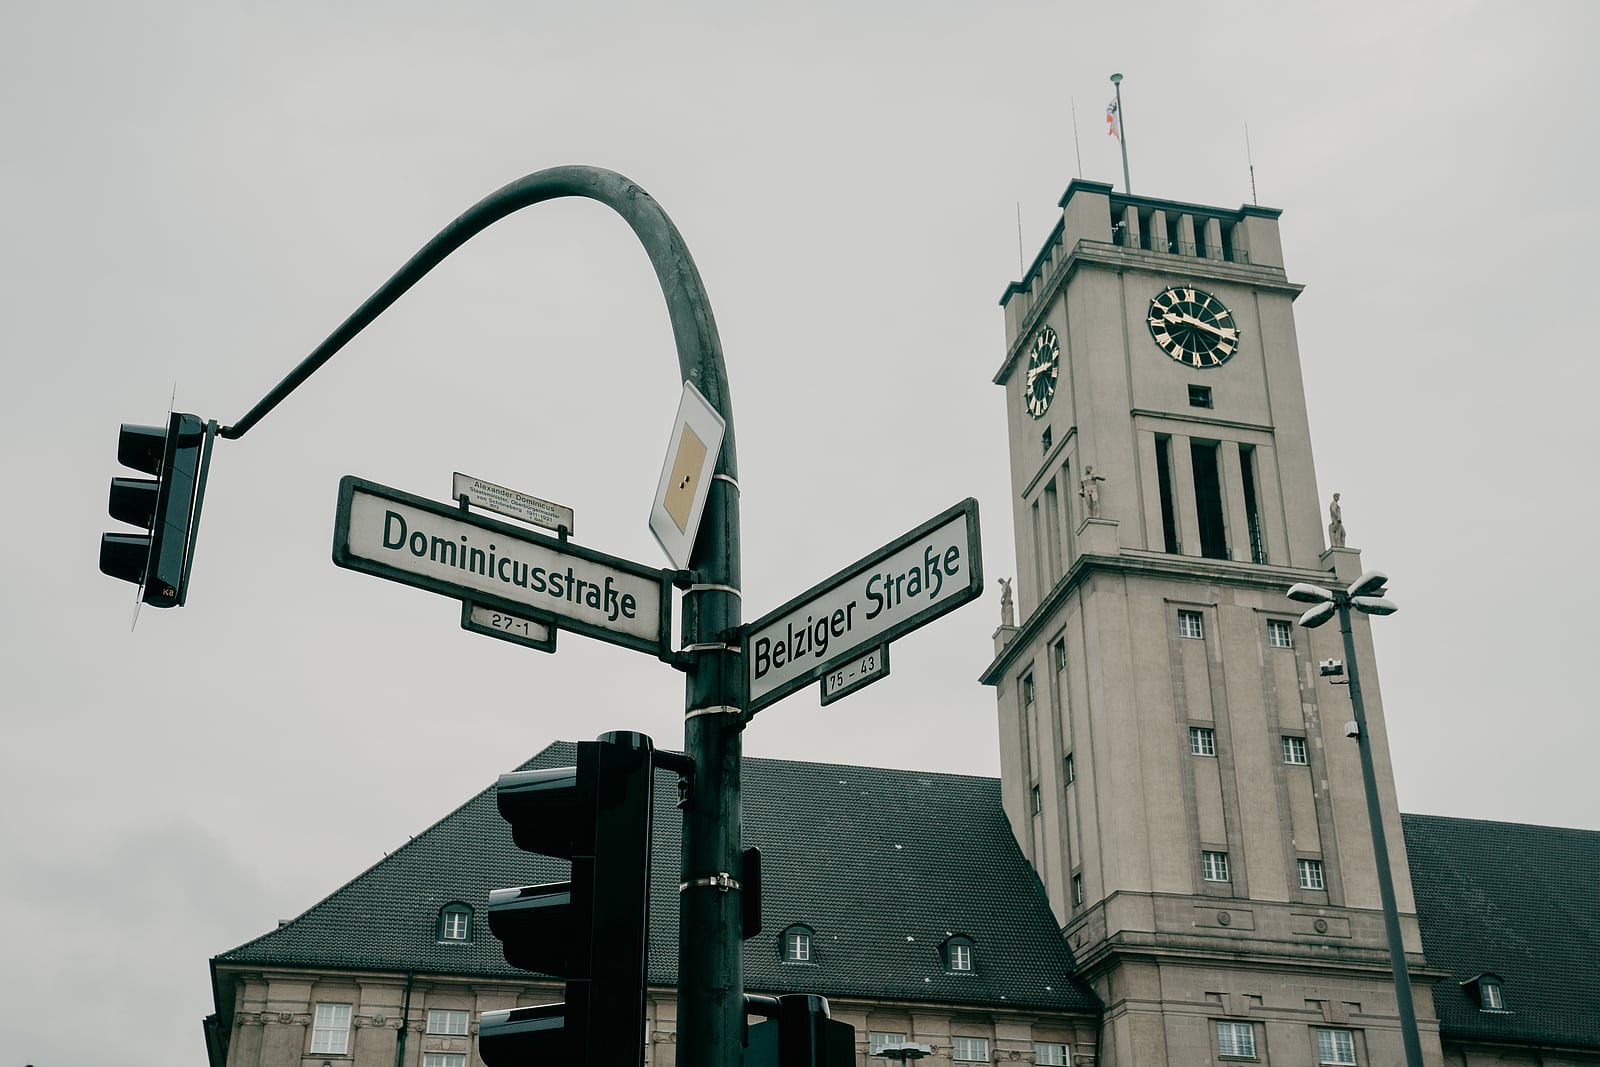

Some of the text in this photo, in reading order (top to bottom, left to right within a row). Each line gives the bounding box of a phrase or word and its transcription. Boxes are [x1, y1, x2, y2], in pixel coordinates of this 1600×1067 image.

[474, 481, 555, 512] Alexander Dominicus
[383, 509, 637, 622] Dominicusstraße
[492, 614, 529, 636] 27-1
[754, 544, 960, 680] Belziger Straße
[830, 671, 843, 690] 75
[860, 656, 875, 674] 43
